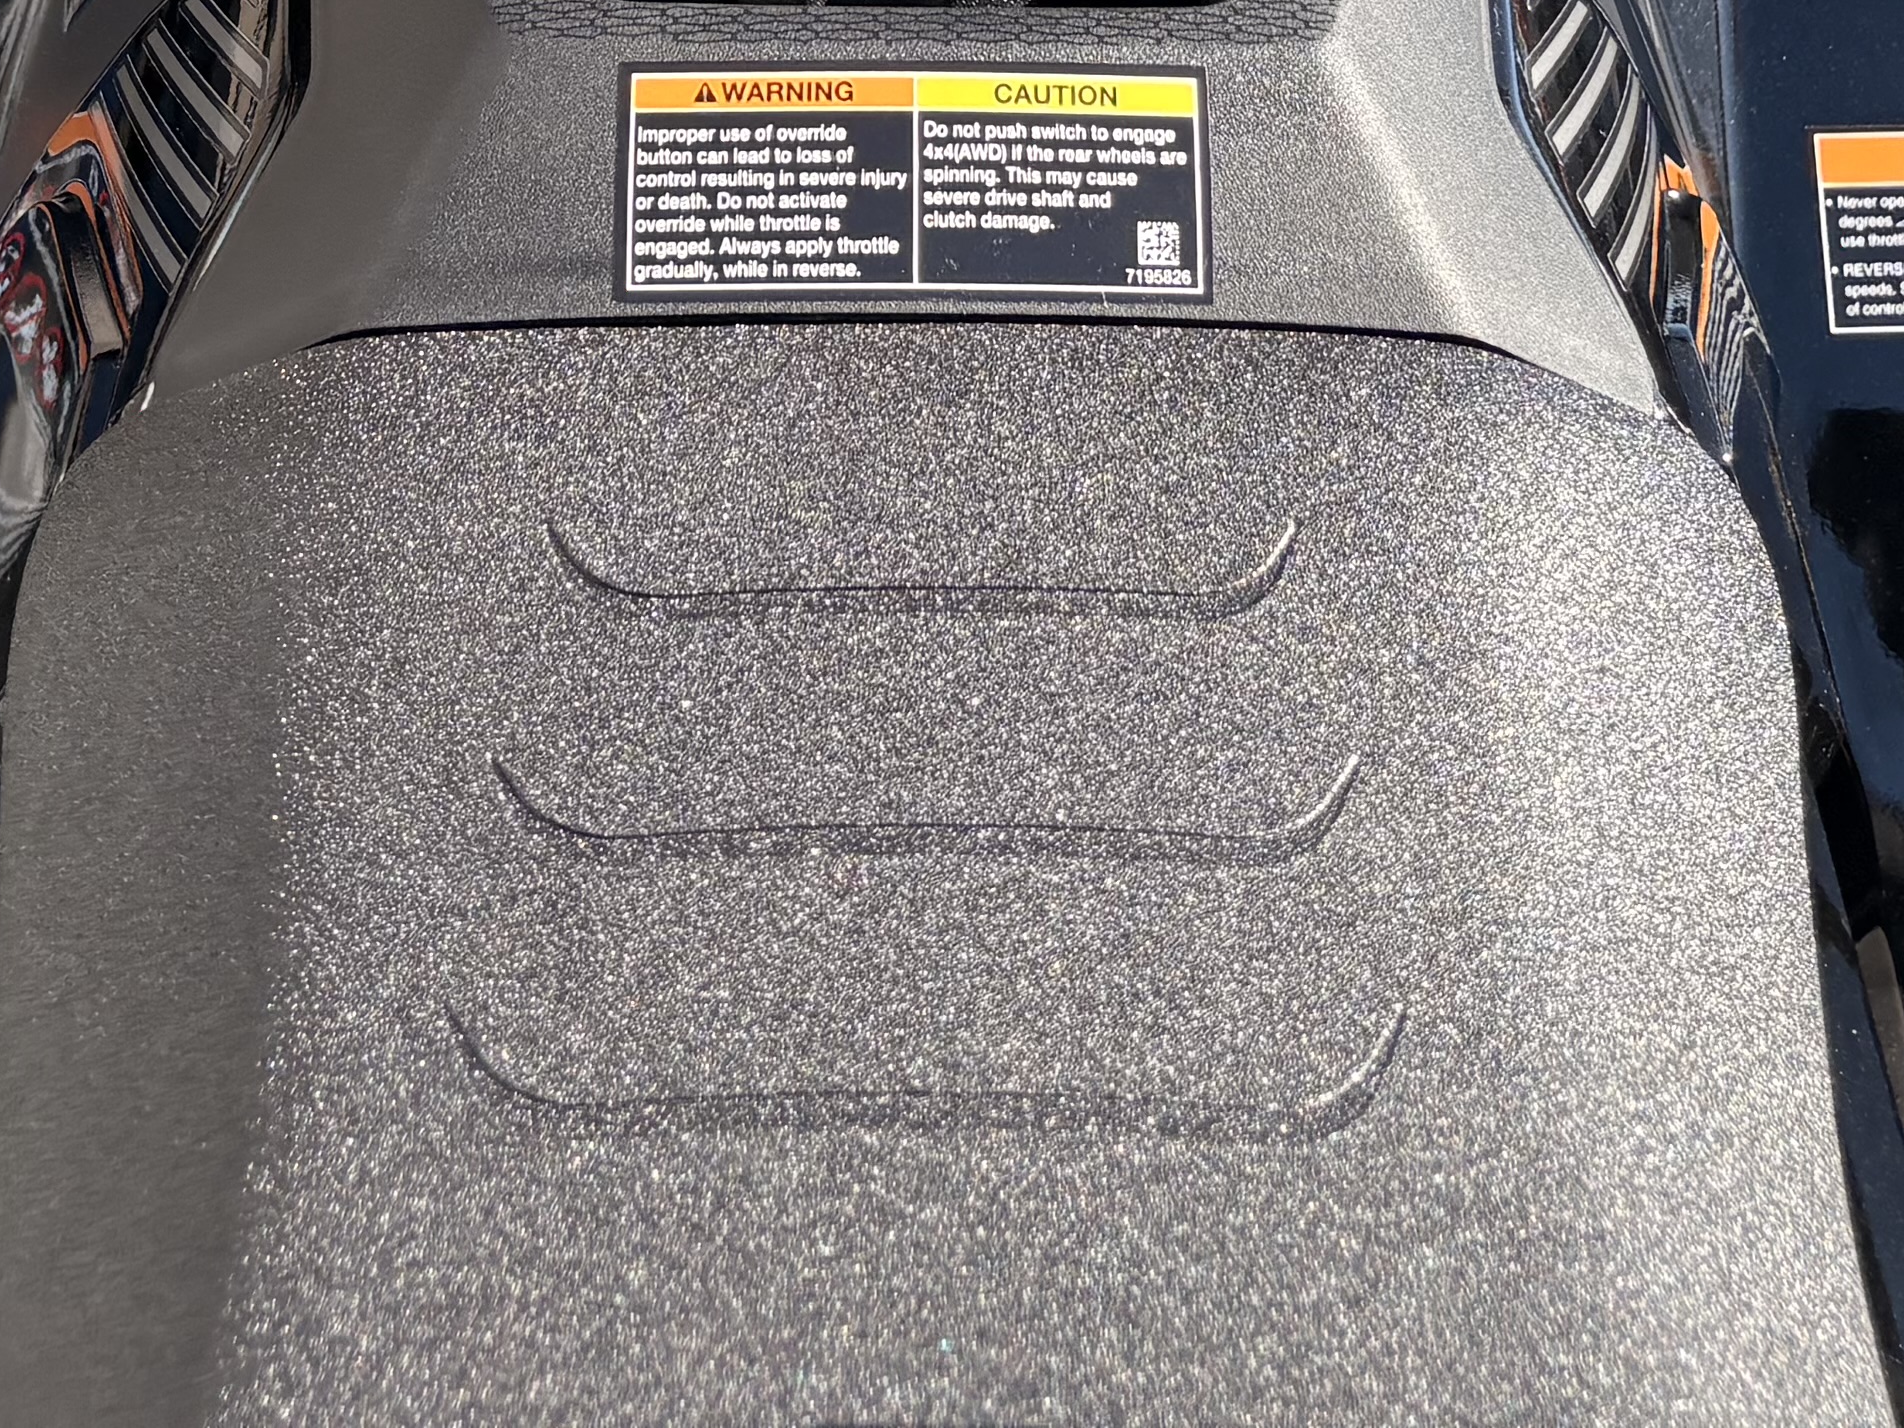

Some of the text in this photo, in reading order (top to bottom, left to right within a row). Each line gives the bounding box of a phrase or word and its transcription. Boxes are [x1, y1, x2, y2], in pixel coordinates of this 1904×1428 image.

[721, 80, 853, 102] WARNING
[994, 83, 1116, 106] CAUTION
[637, 124, 847, 146] Improper use of override
[923, 166, 1138, 188] spinning. This may cause
[922, 210, 1055, 233] clutch damage.
[633, 260, 861, 282] gradually, while in reverse.
[1125, 267, 1192, 285] 7195826
